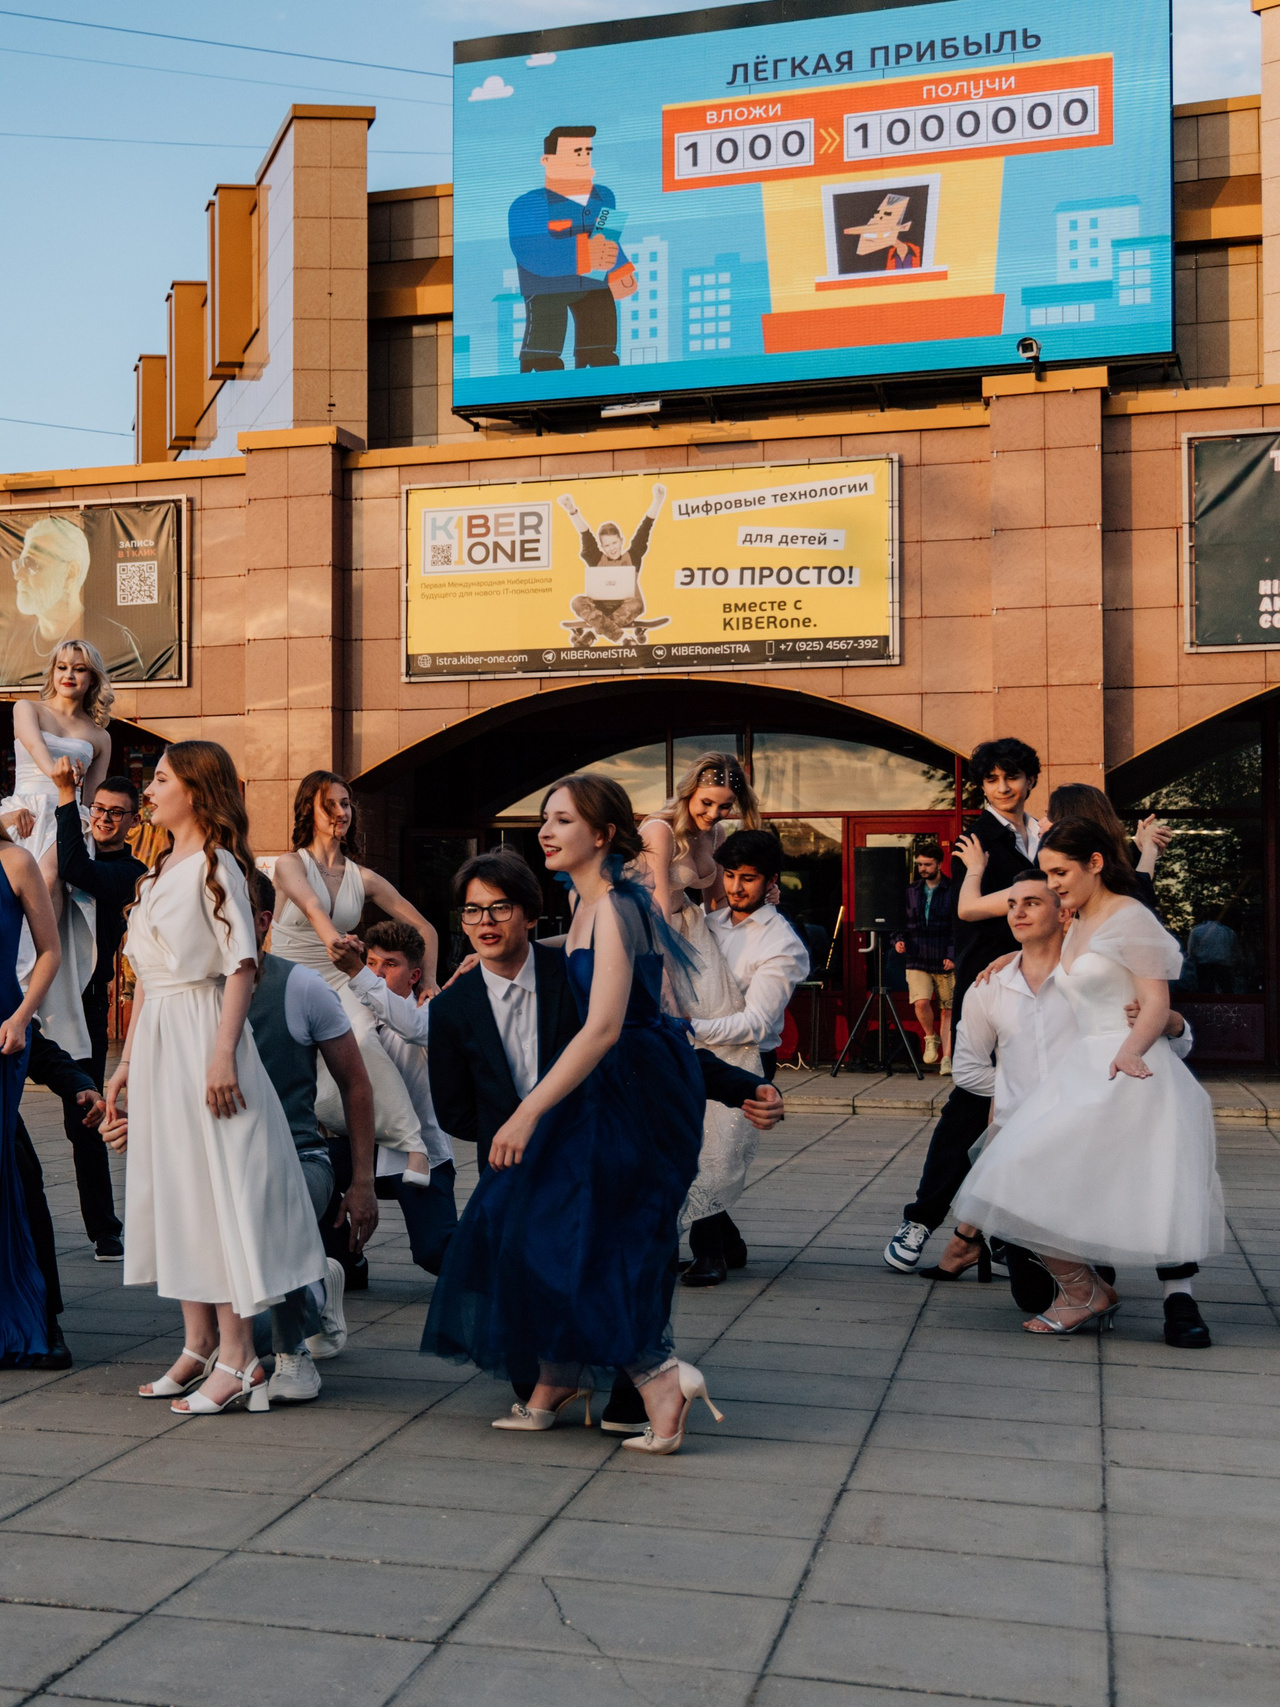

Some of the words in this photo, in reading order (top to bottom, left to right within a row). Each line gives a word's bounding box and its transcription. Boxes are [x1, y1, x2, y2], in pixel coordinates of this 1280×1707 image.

[726, 50, 853, 86] ЛЁГКАЯ
[870, 27, 1042, 69] ПРИБЫЛЬ
[923, 76, 1016, 99] получи
[706, 103, 781, 124] вложи
[853, 98, 1089, 149] 1000000
[683, 130, 805, 168] 1000
[595, 209, 610, 231] 1000
[678, 495, 766, 517] Цифровые
[771, 481, 869, 504] технологии
[119, 540, 155, 548] ЗАПИСЬ
[742, 532, 773, 545] для
[778, 532, 828, 547] детей
[132, 549, 156, 557] КЛИК
[467, 538, 541, 565] ONE
[680, 566, 729, 586] ЭТО
[739, 565, 854, 585] ПРОСТО!
[723, 600, 787, 613] вместе
[794, 600, 802, 610] с
[723, 616, 817, 631] KIBERone.
[561, 648, 637, 660] KIBERoneISTRA
[671, 644, 750, 656] KIBERoneISTRA
[779, 642, 793, 651] +7
[795, 641, 823, 651] (925)
[825, 639, 878, 650] 4567-392
[436, 654, 528, 665] istra.kiber-one.com
